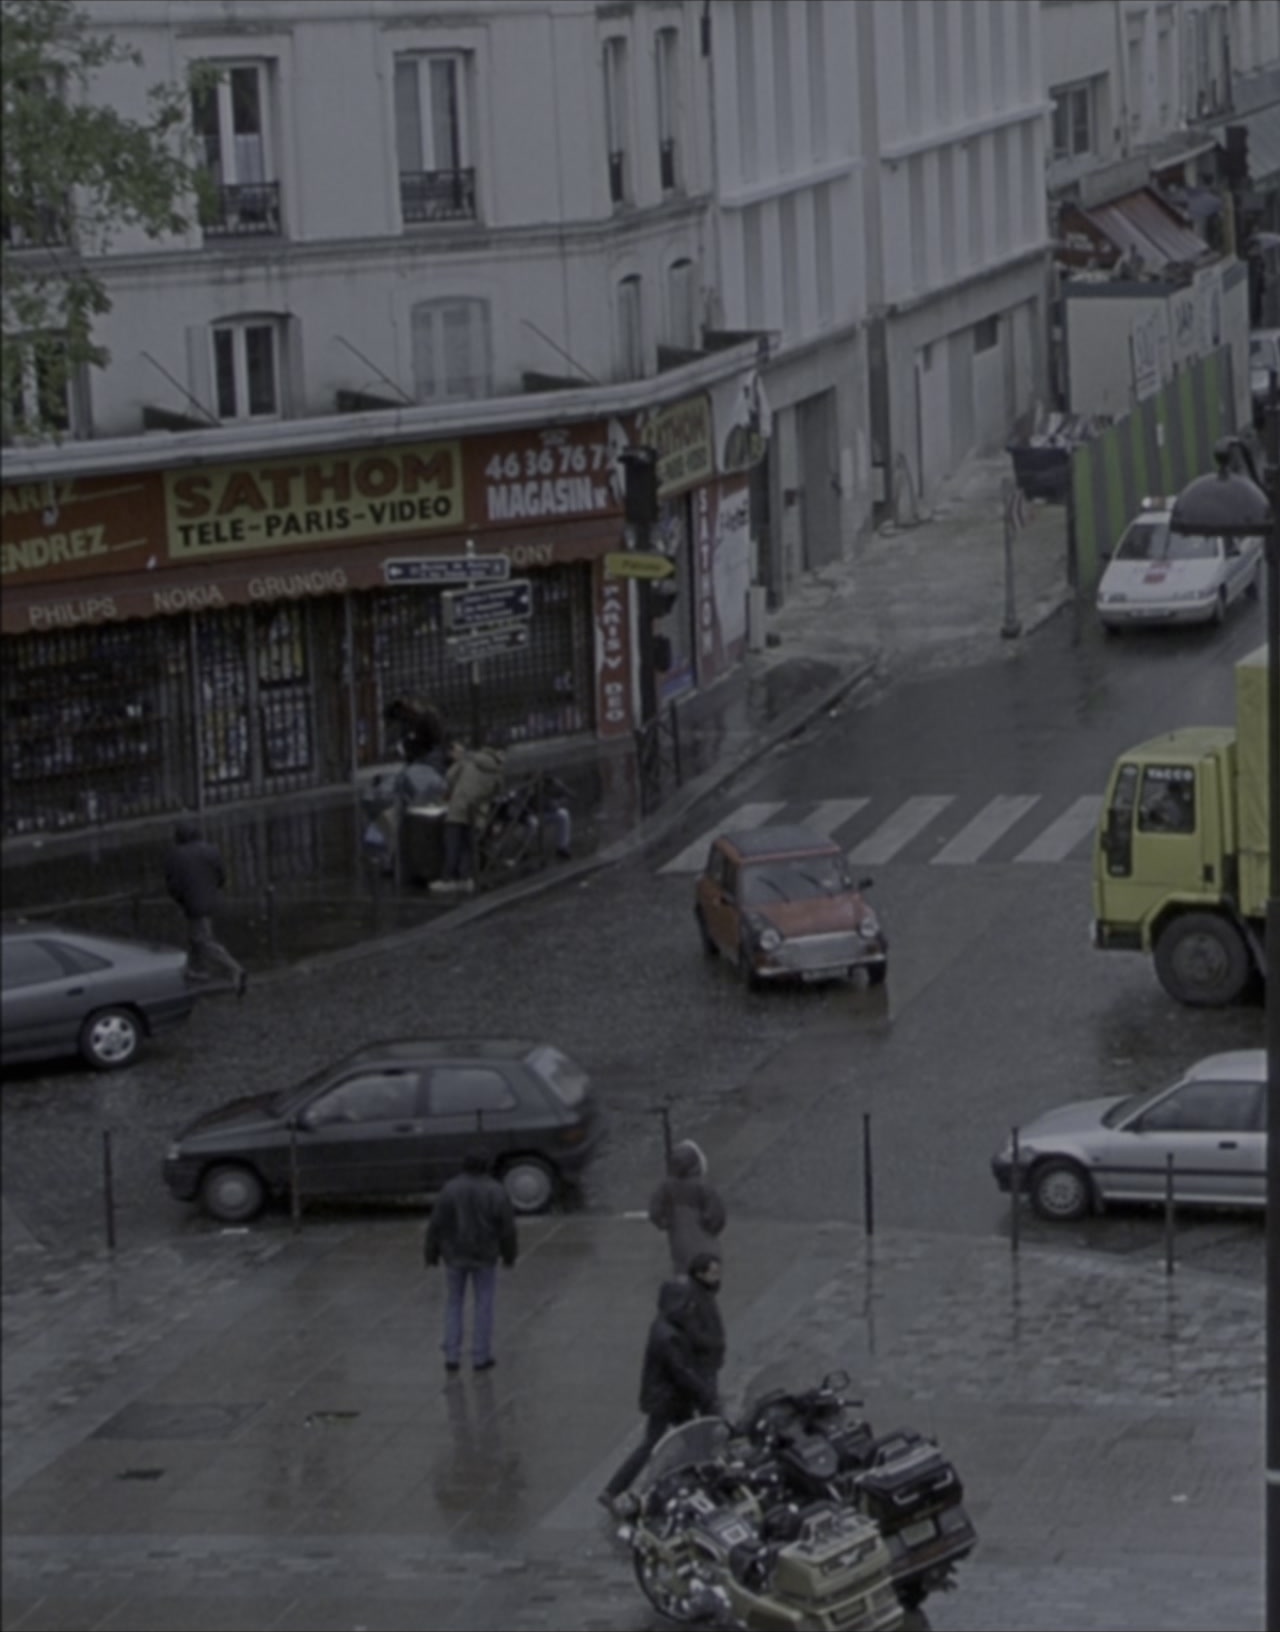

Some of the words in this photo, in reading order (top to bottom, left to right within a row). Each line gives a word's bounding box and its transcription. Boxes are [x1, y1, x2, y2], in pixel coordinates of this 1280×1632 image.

[171, 449, 457, 519] SATHOM
[487, 475, 593, 520] MAGASIN
[28, 596, 118, 626] PHILIPS
[153, 584, 225, 612] NOKIA
[248, 566, 348, 600] GRUNDIG
[502, 543, 556, 567] SONY
